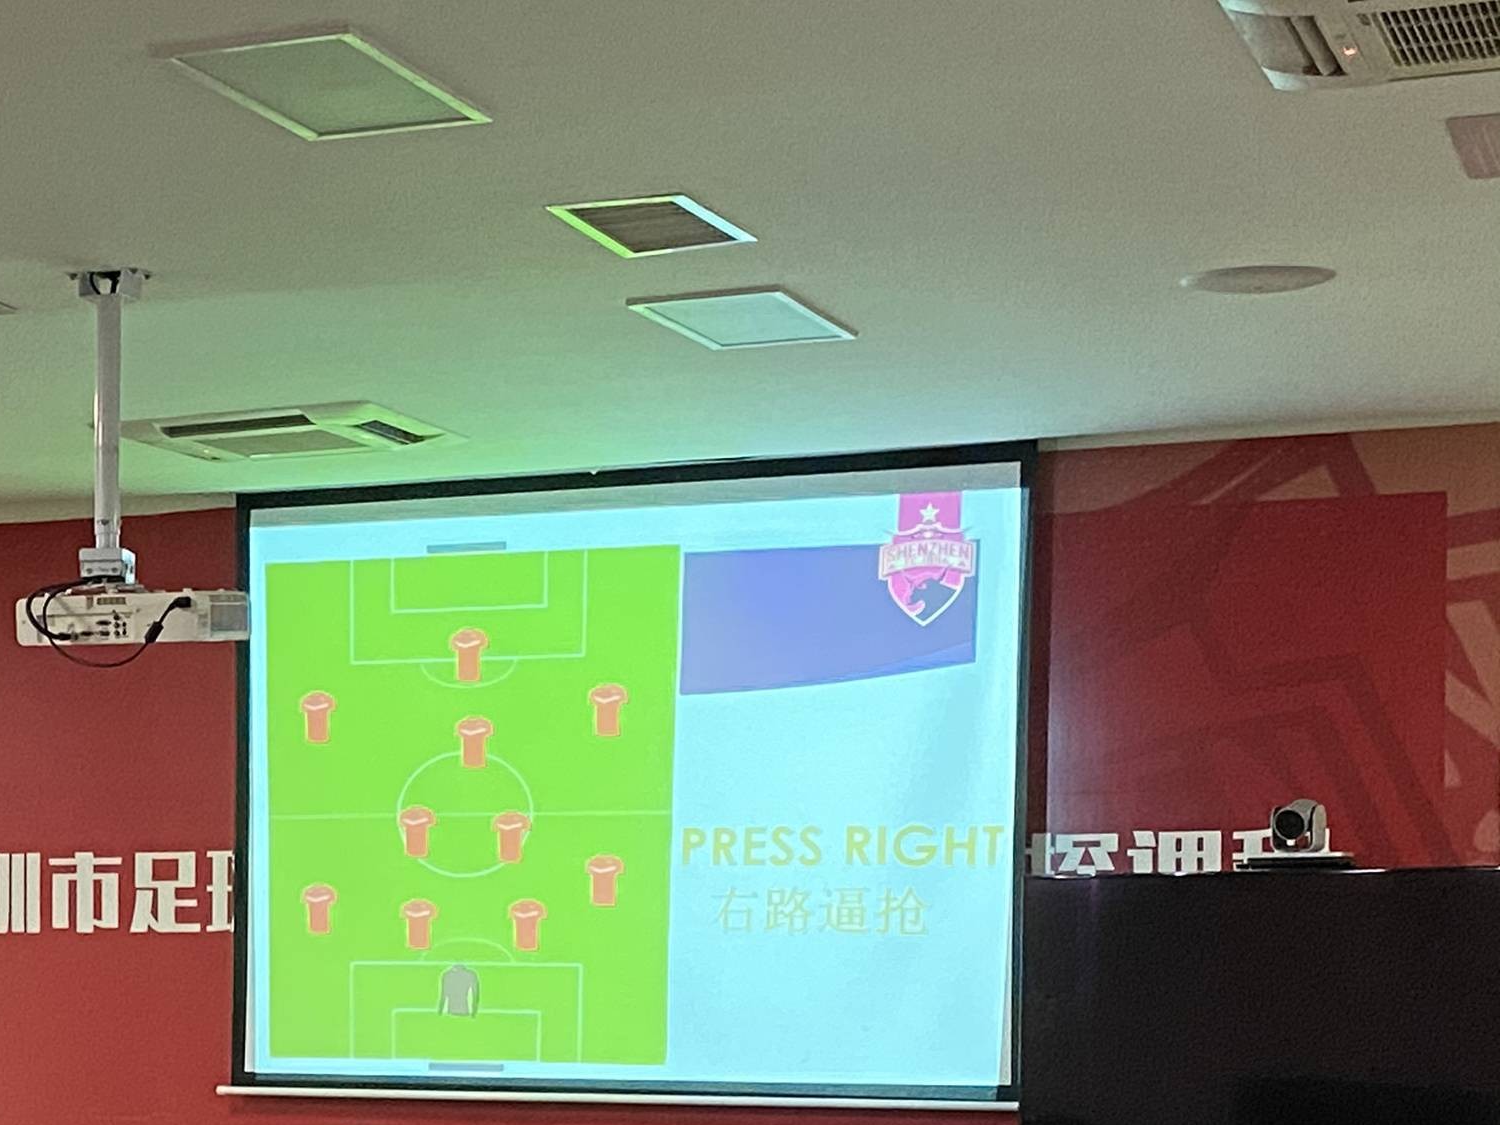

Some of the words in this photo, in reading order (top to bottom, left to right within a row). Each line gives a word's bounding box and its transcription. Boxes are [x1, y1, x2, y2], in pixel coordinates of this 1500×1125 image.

[886, 541, 970, 561] SHENZHEN
[681, 825, 823, 867] PRESS
[845, 823, 1005, 868] RIGHT
[711, 885, 932, 936] 右路逼抢
